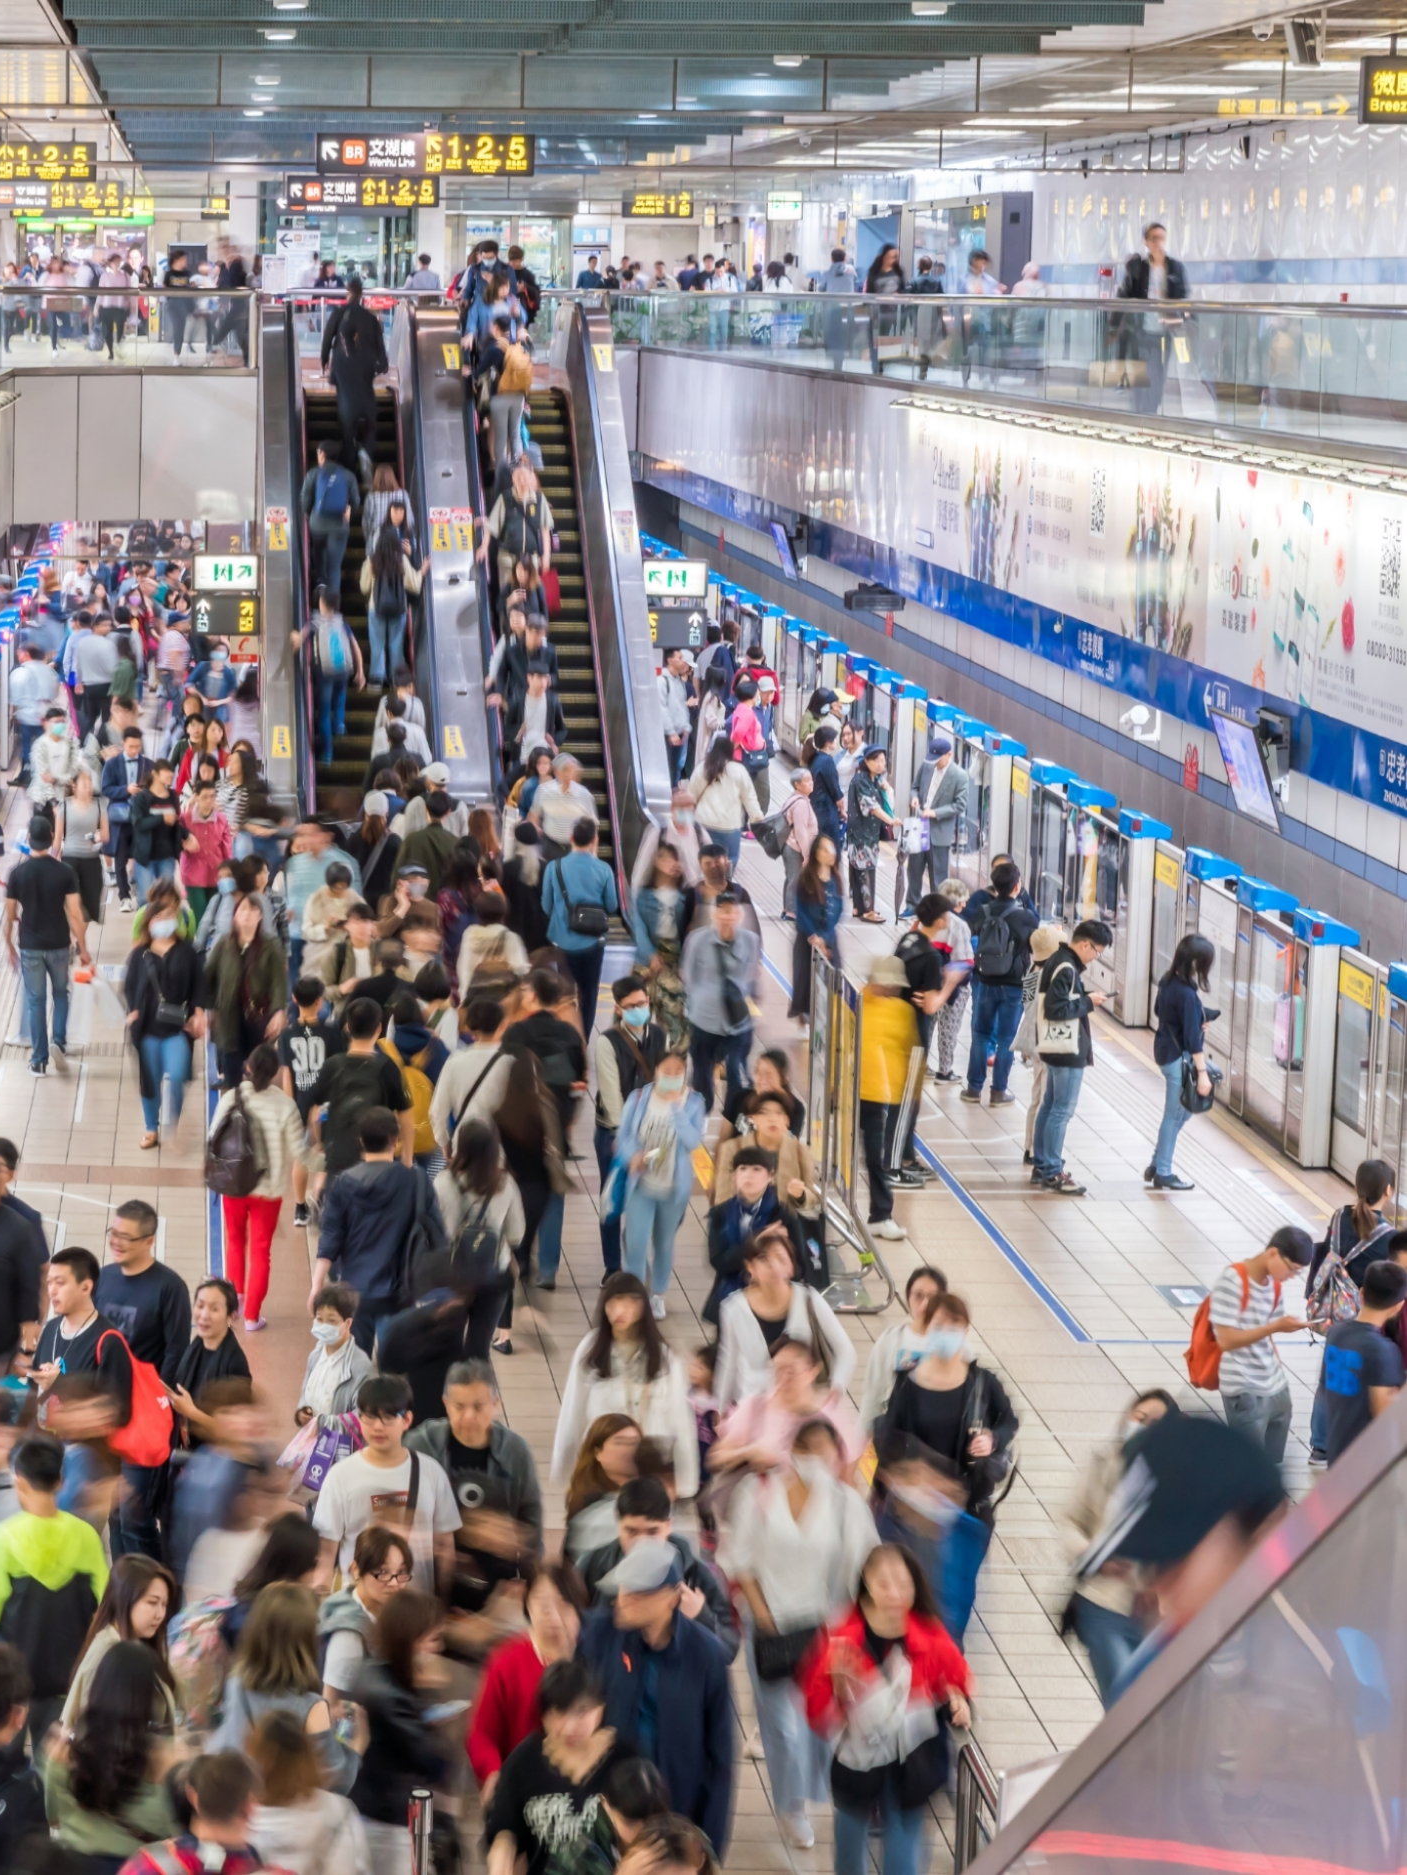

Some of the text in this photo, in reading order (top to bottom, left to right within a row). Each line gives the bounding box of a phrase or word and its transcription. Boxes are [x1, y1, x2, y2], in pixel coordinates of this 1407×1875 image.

[345, 146, 364, 159] BR
[368, 138, 416, 157] 文湖線
[368, 157, 416, 168] Wenhu Line
[306, 186, 321, 197] BR
